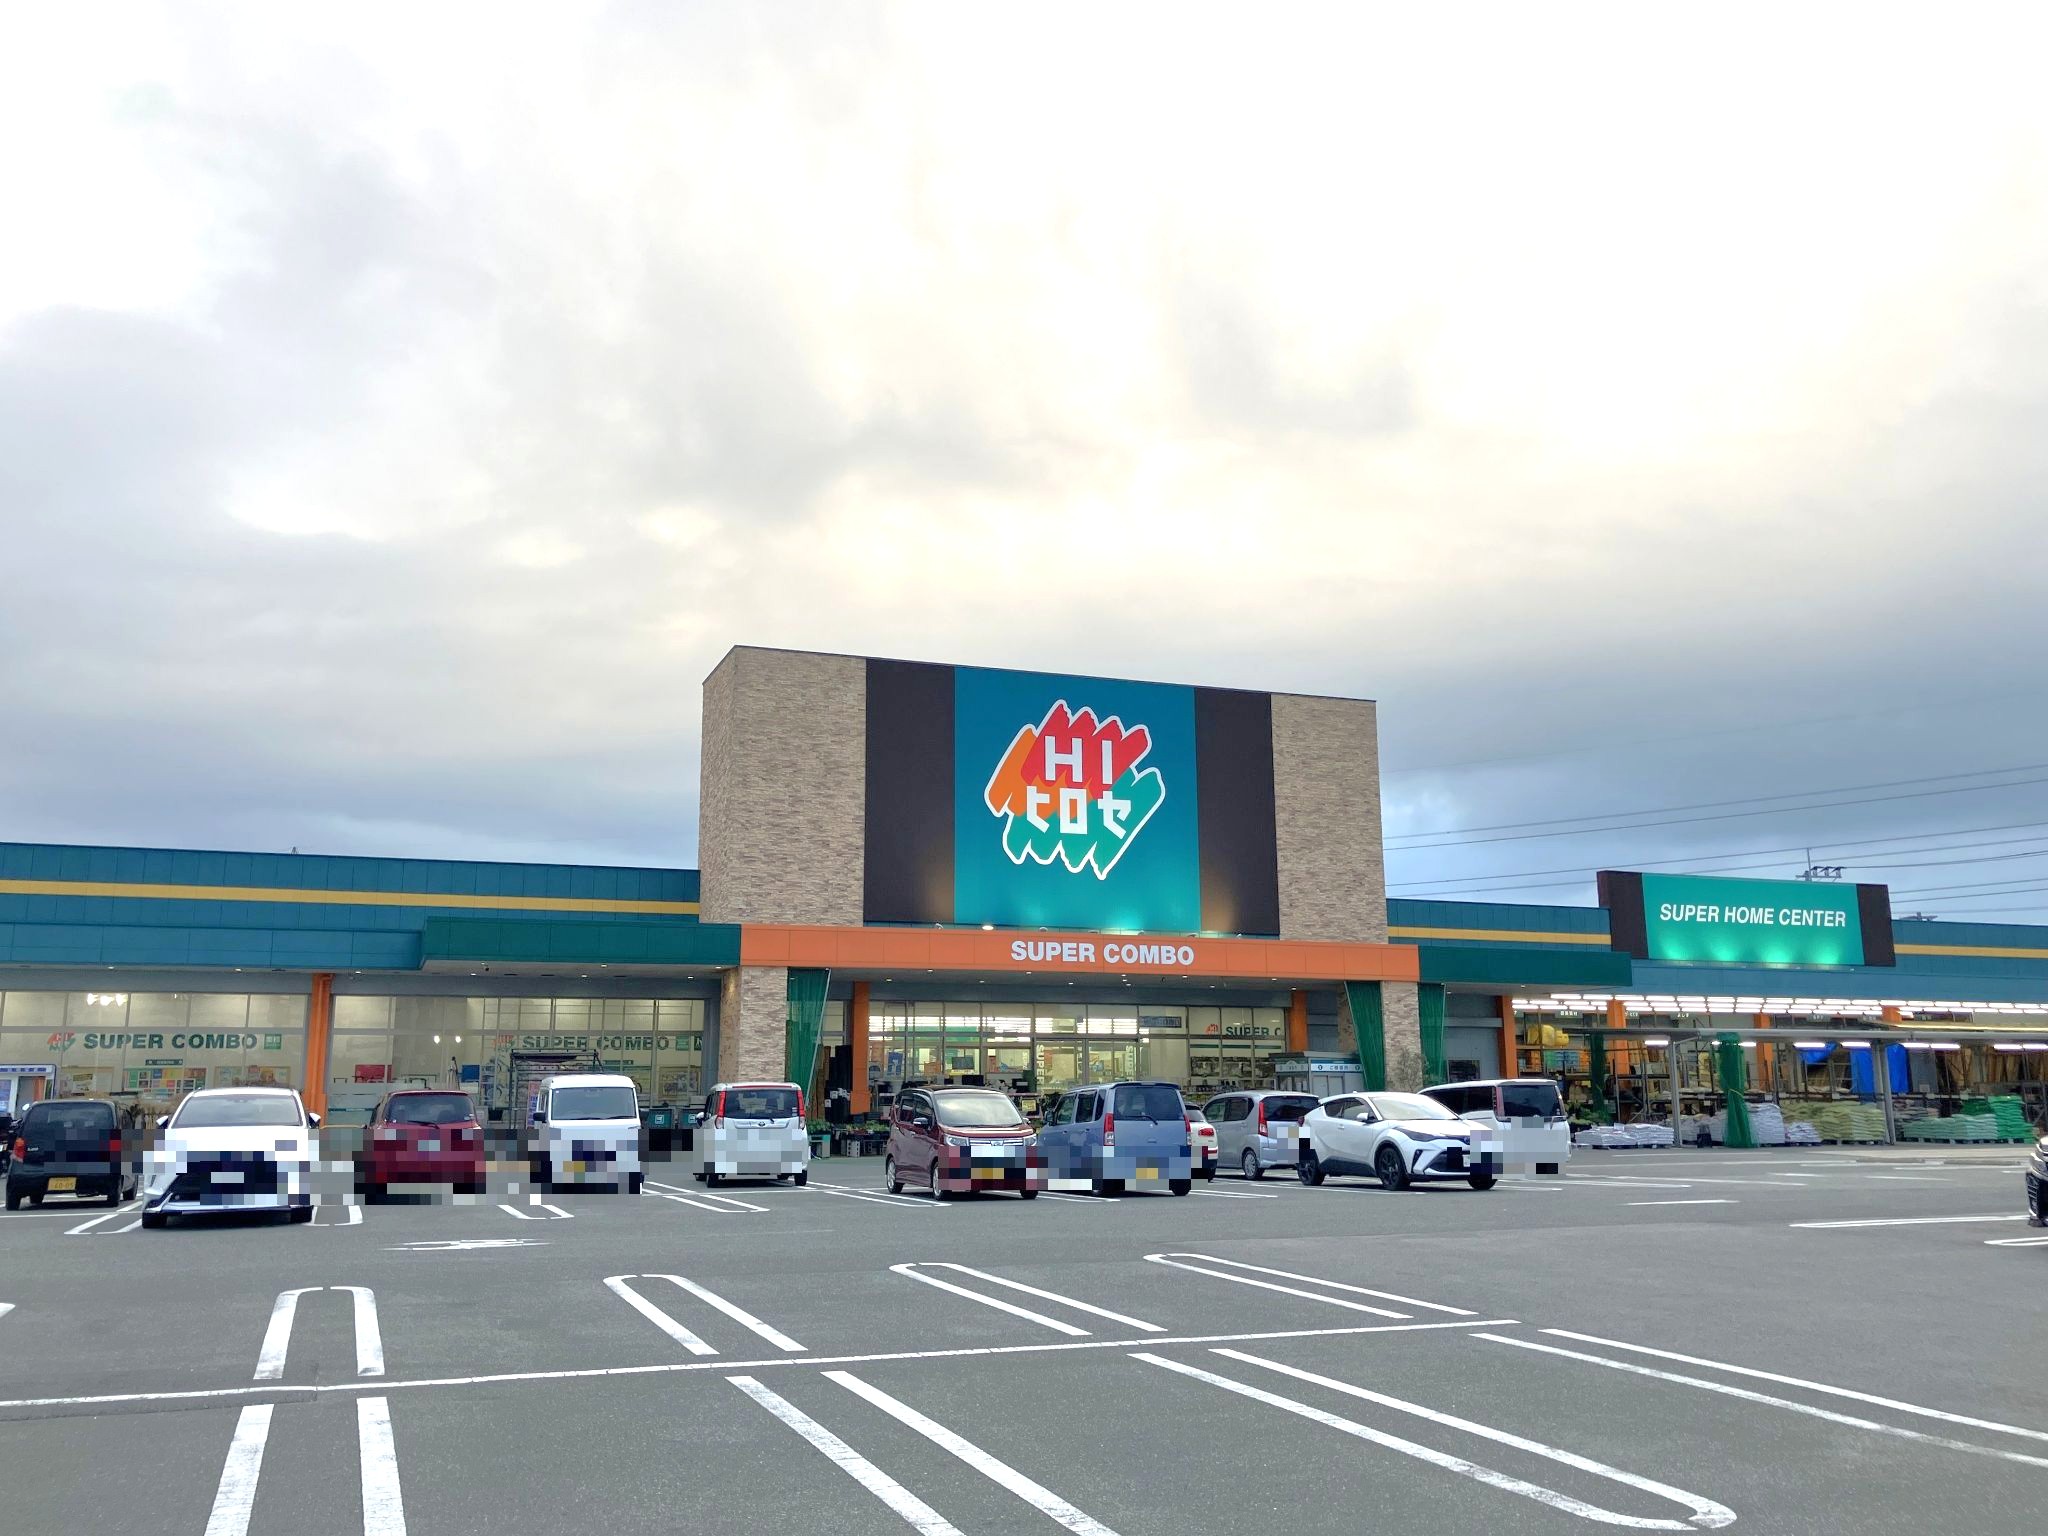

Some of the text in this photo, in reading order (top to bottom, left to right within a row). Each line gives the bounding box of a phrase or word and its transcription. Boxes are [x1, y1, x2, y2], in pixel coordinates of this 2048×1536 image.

[1044, 735, 1113, 785] HI
[1026, 785, 1132, 840] ヒロセ
[1660, 903, 1846, 928] SUPER HOME CENTER
[1011, 940, 1195, 966] SUPER COMBO
[83, 1033, 164, 1049] SUPER
[171, 1033, 258, 1050] COMBO
[522, 1035, 589, 1050] SUPER
[596, 1035, 669, 1050] COMBO
[1036, 1044, 1045, 1085] SUPER
